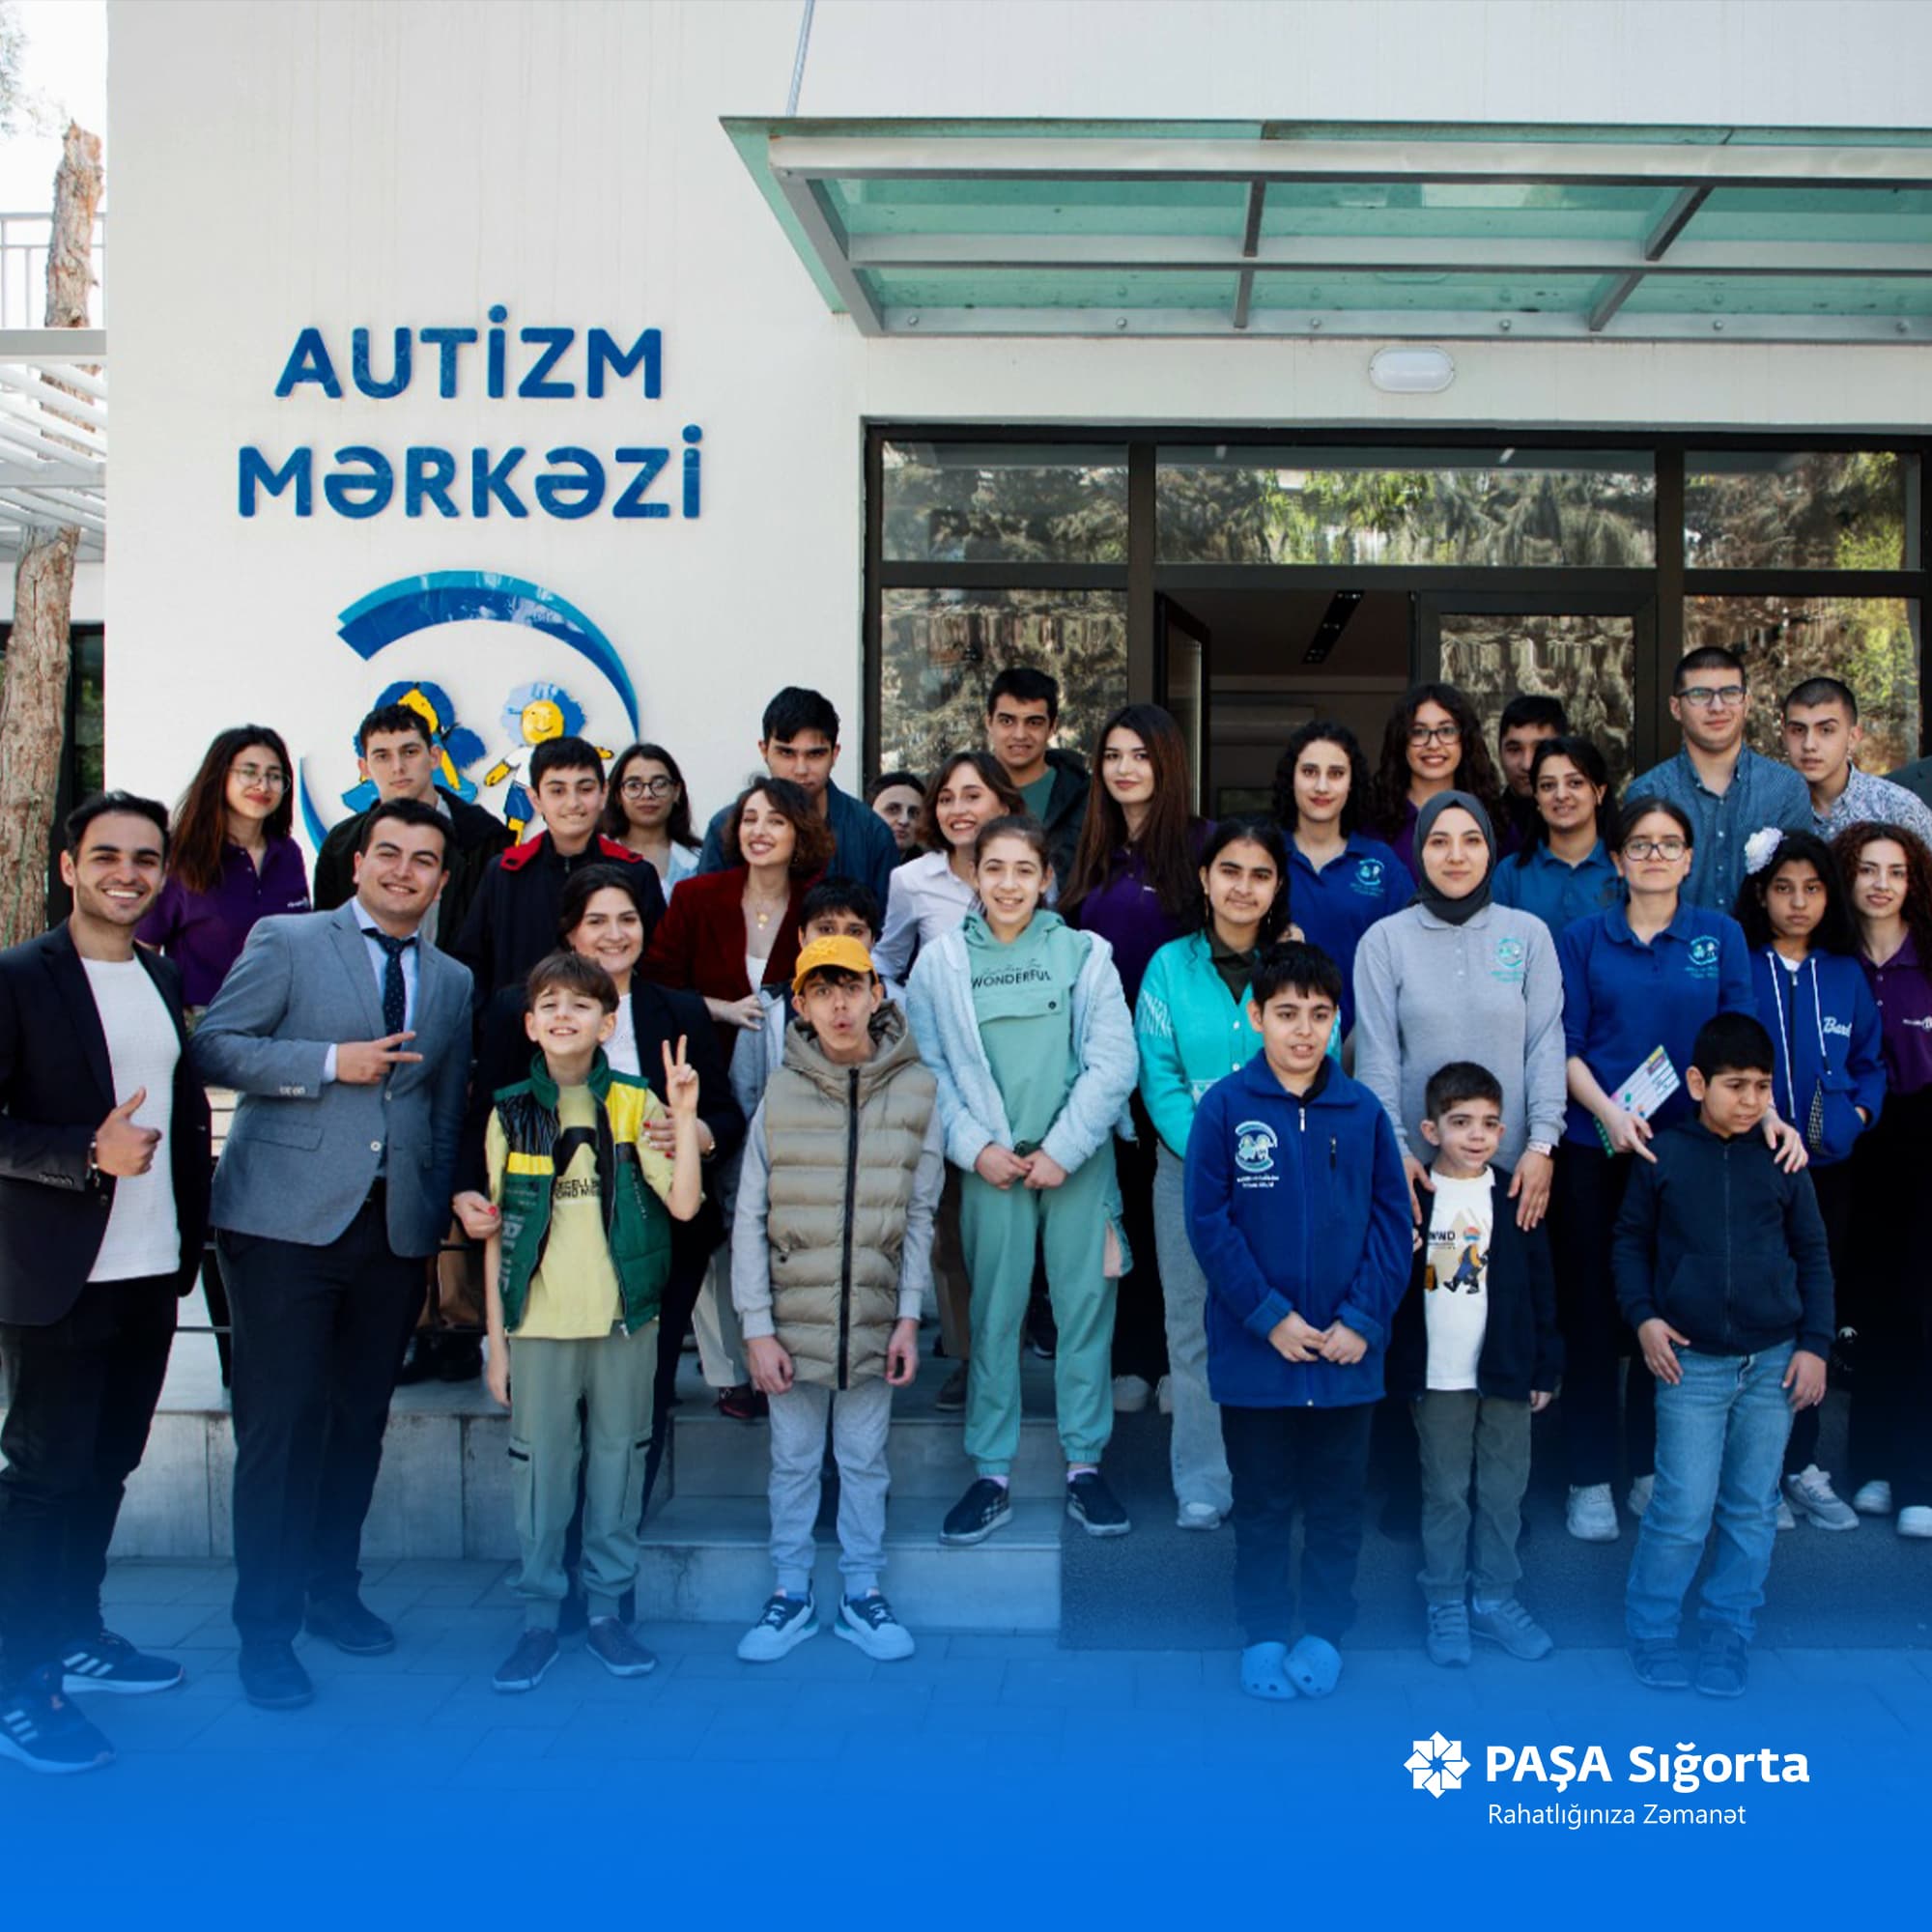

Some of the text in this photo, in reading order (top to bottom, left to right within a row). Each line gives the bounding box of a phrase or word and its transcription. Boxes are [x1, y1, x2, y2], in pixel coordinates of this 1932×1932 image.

[274, 304, 663, 399] AUTİZM
[239, 424, 703, 520] MƏRKƏZİ
[972, 969, 1052, 989] WONDERFUL
